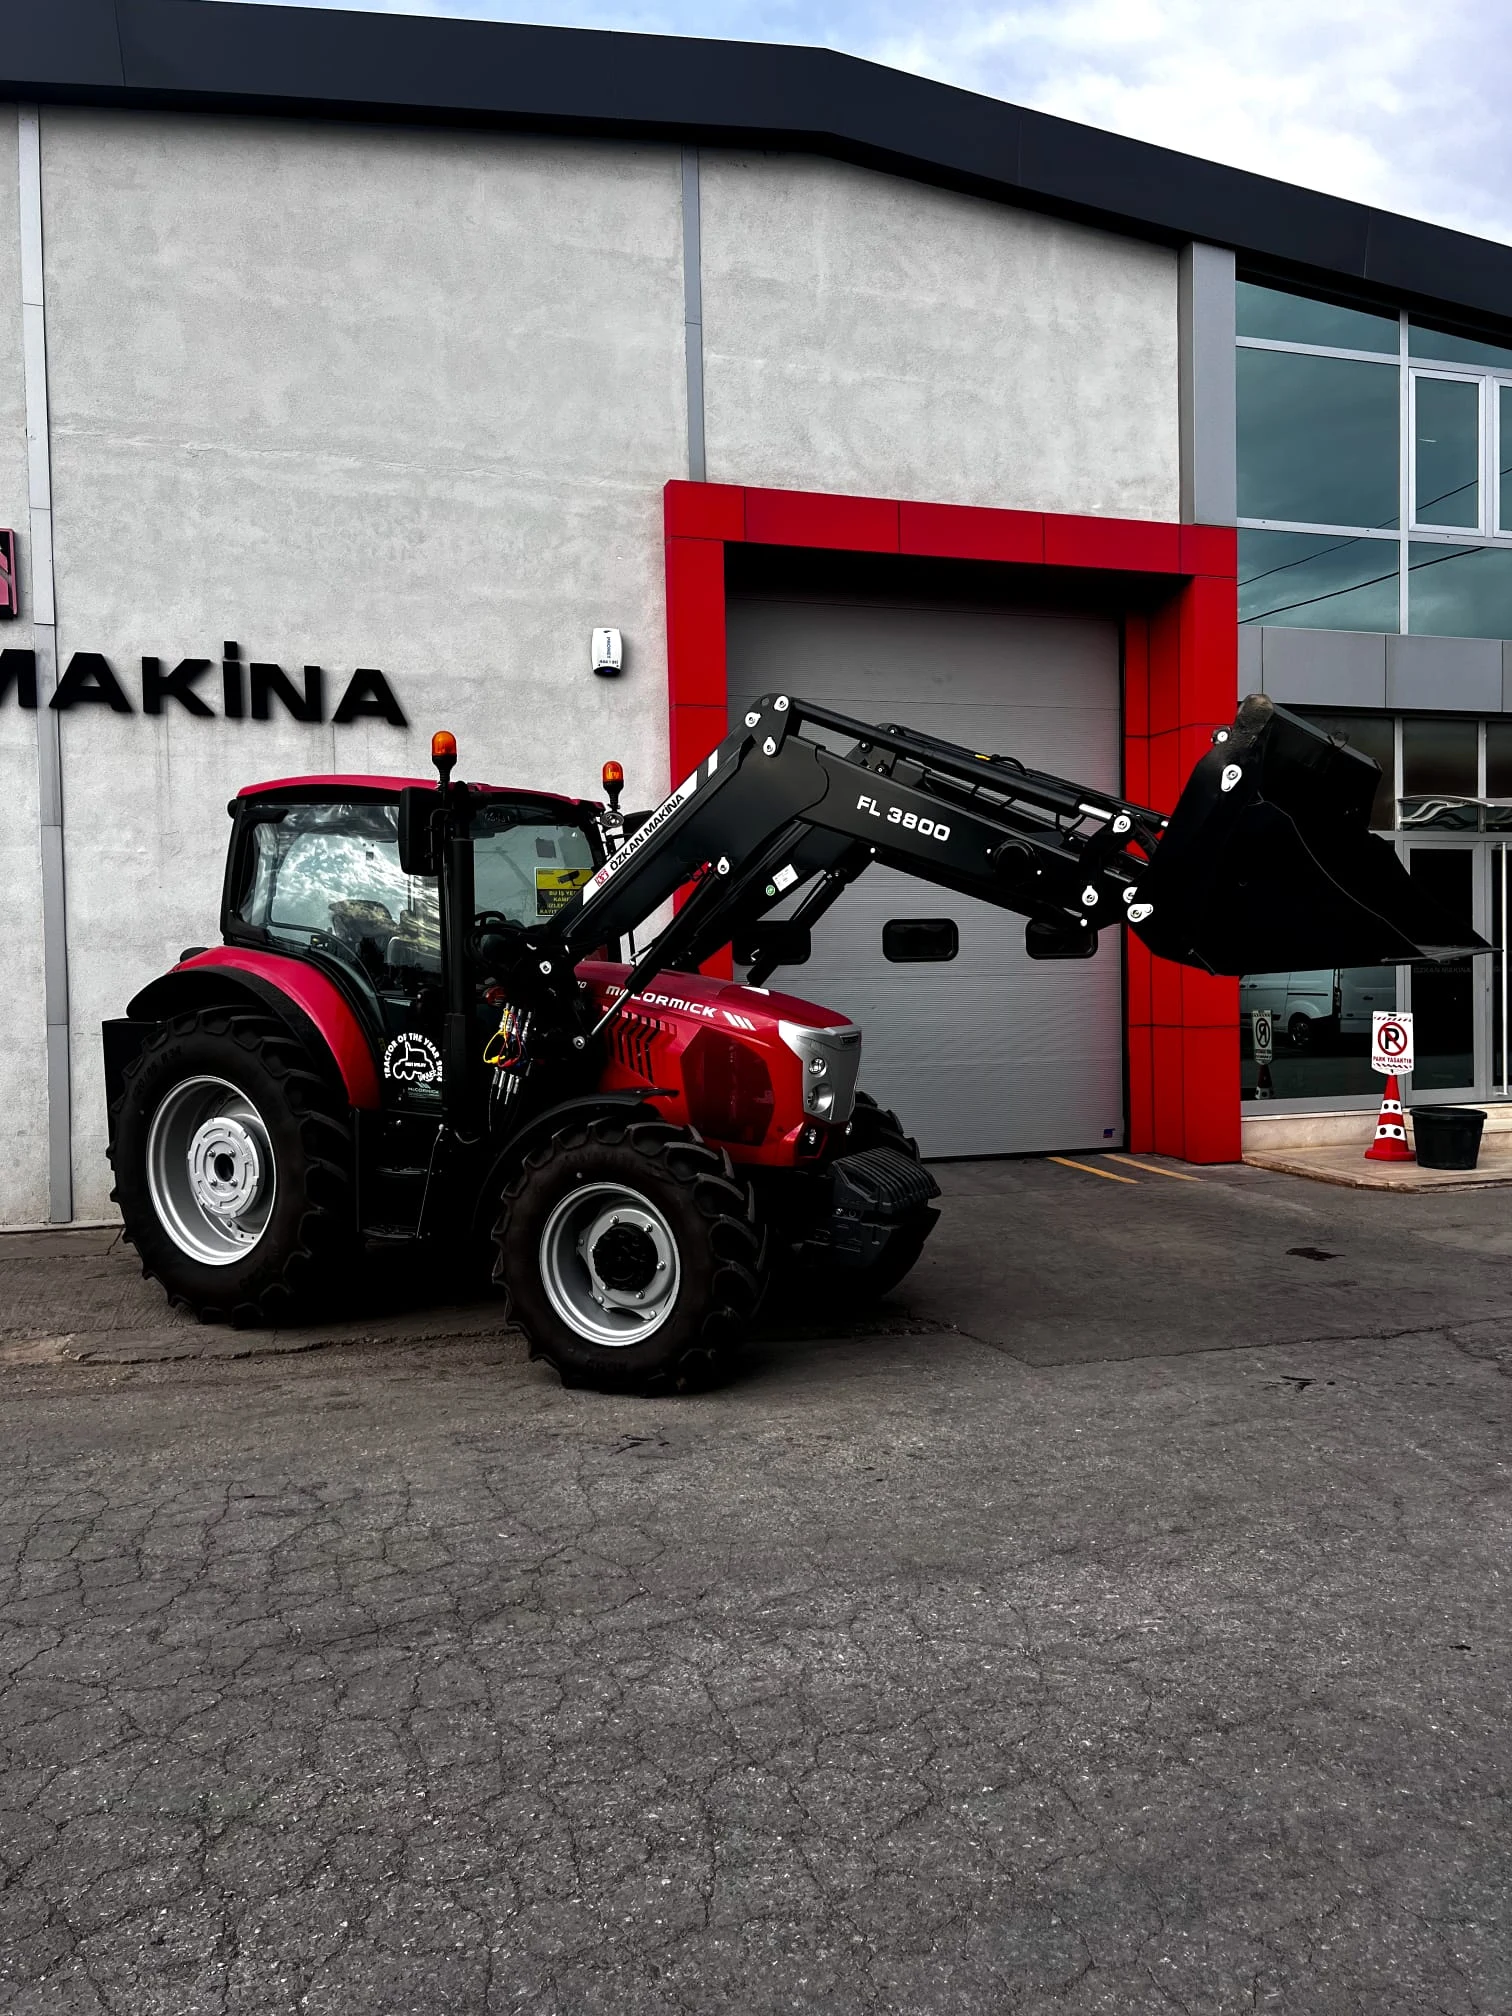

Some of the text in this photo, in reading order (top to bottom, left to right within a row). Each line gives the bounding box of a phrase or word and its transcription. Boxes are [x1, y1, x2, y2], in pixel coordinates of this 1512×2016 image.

[610, 794, 685, 871] ÖZKAN MAKİNA
[857, 795, 951, 842] FL 3800
[383, 1040, 398, 1079] TRACTOR
[397, 1033, 407, 1043] OF
[408, 1032, 423, 1043] THE
[423, 1037, 440, 1060] YEAR
